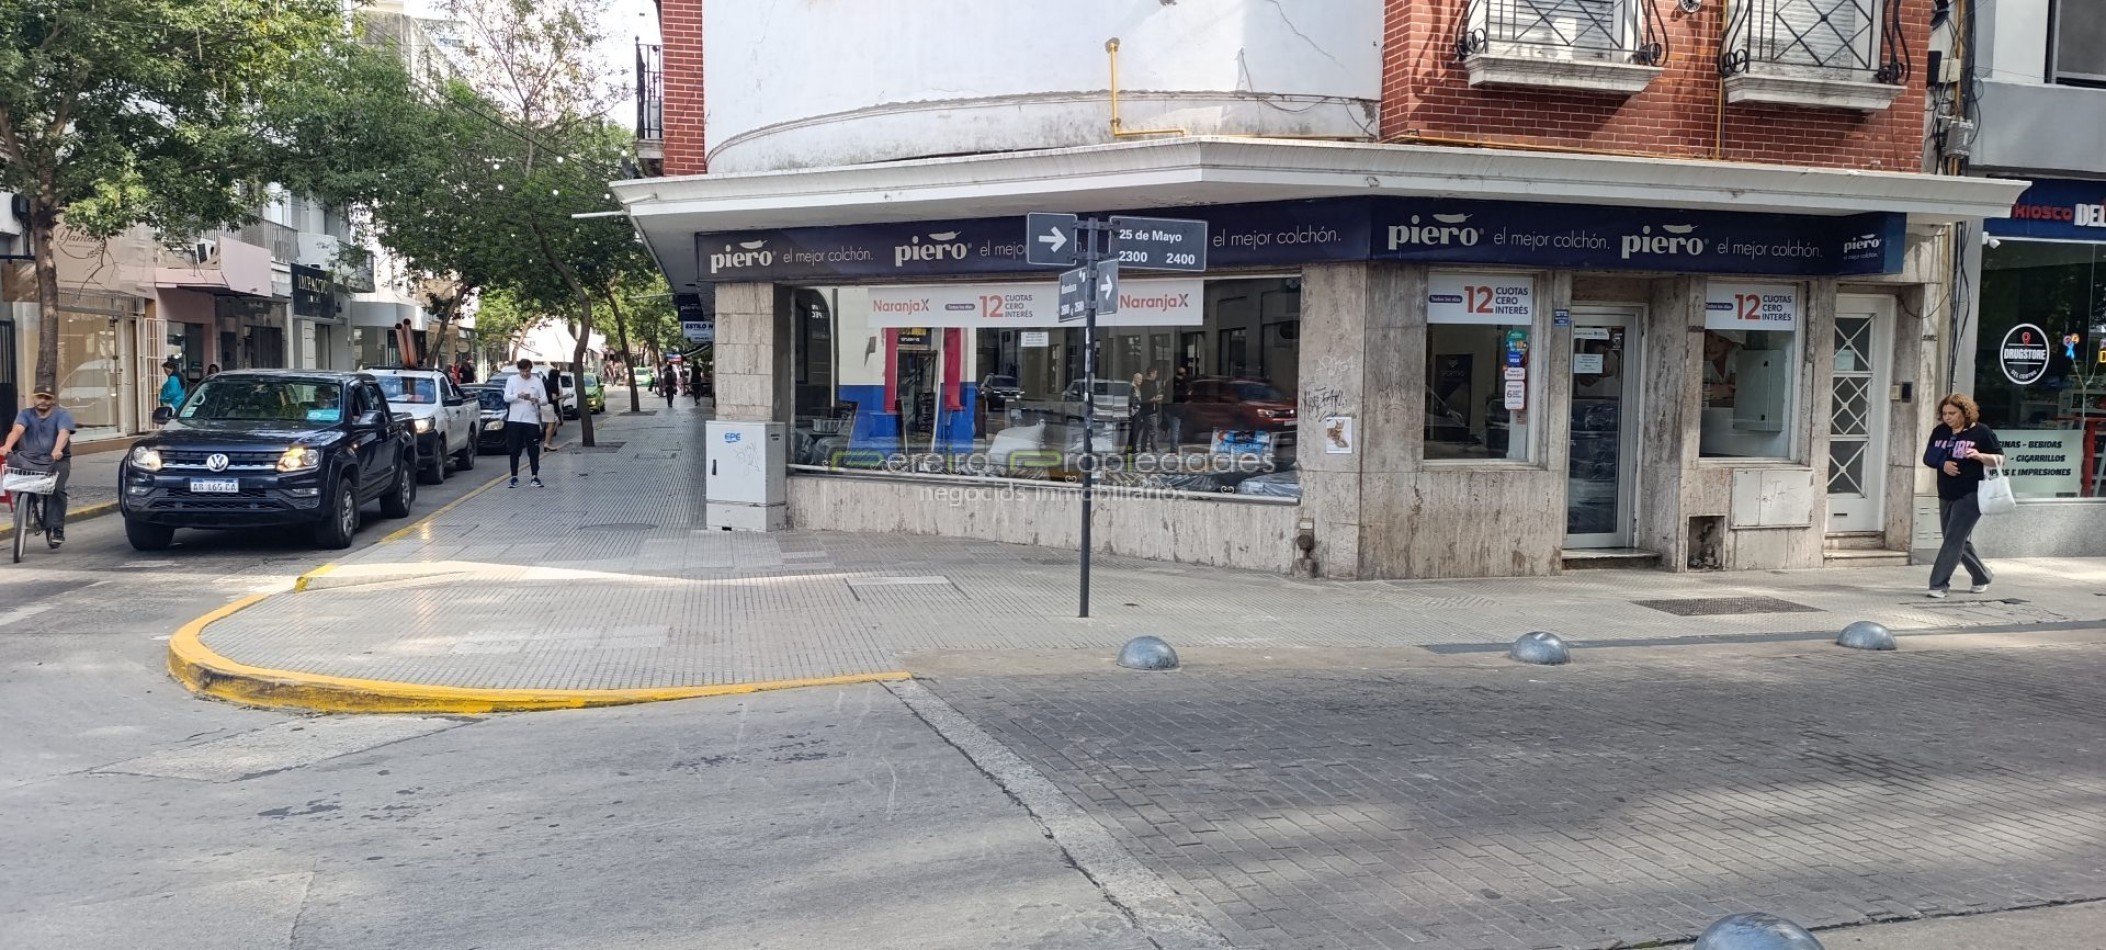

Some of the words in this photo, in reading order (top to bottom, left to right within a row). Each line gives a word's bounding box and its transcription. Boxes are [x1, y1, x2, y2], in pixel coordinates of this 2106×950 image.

[1119, 229, 1133, 240] 25
[1135, 230, 1149, 240] de
[1152, 230, 1182, 244] Mayo
[1213, 228, 1226, 247] el
[1231, 230, 1273, 251] mejor
[1277, 224, 1341, 244] colchón.
[1388, 214, 1479, 250] piero
[1494, 227, 1506, 245] el
[1511, 231, 1550, 251] mejor
[1553, 230, 1610, 249] colchón.
[1621, 225, 1704, 259] piero
[1717, 237, 1729, 254] el
[1733, 241, 1768, 260] mejor
[1771, 241, 1823, 258] colchón.
[1843, 237, 1880, 254] piero
[895, 235, 967, 267] piero
[979, 240, 991, 257] el
[995, 241, 1028, 260] mejo
[710, 244, 773, 274] piero
[783, 248, 793, 263] el
[795, 249, 825, 267] mejor
[828, 246, 874, 262] colchón.
[1118, 250, 1148, 263] 2300
[1165, 252, 1196, 265] 2400
[1495, 287, 1529, 295] CUOTAS
[1464, 286, 1494, 314] 12
[1495, 297, 1518, 305] CERO
[1762, 294, 1792, 303] CUOTAS
[979, 295, 1004, 318] 12
[1495, 305, 1529, 315] INTERÉS
[1734, 294, 1761, 320] 12
[1762, 304, 1783, 312] CERO
[1005, 310, 1033, 318] INTERÉS
[1762, 312, 1792, 321] INTERÉS
[2003, 348, 2047, 360] DRUGSTORE
[724, 432, 741, 441] EPE
[2028, 441, 2062, 449] BEBIDAS
[2016, 454, 2066, 463] CIGARRILLOS
[2017, 468, 2071, 476] IMPRESIONES
